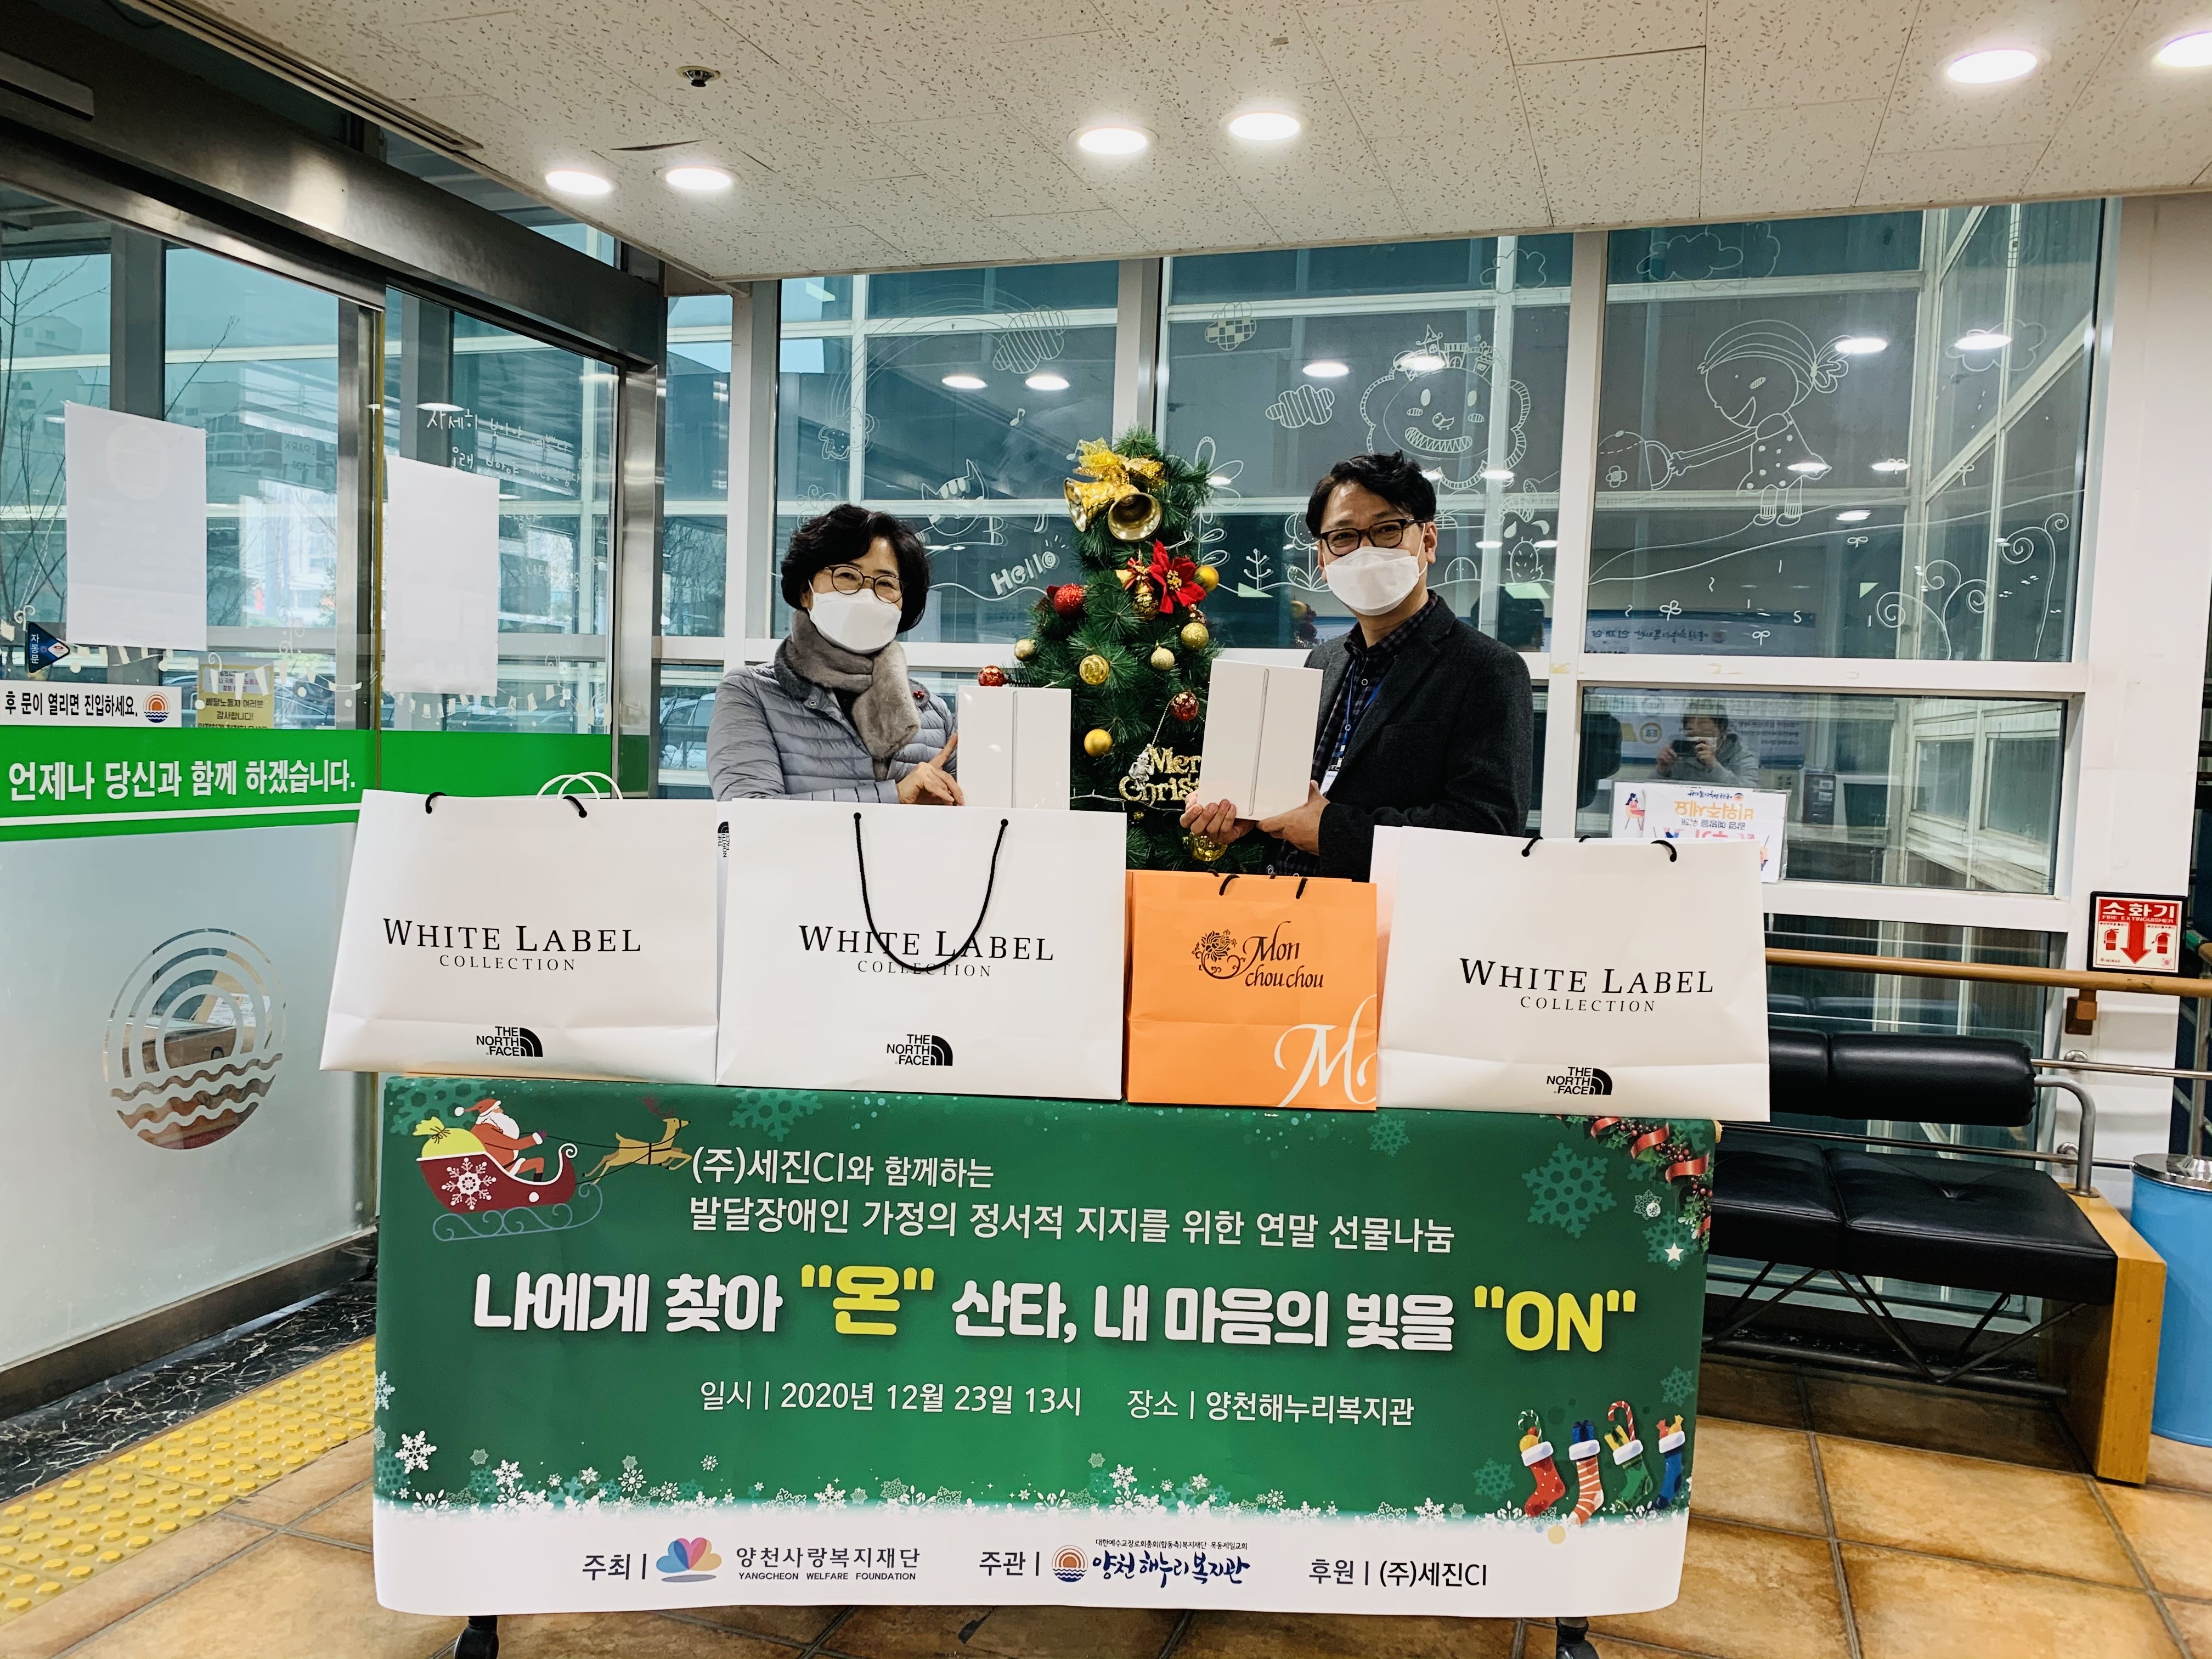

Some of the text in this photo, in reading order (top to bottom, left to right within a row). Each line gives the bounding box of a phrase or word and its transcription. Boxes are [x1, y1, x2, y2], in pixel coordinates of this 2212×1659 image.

[991, 551, 1056, 595] Hello
[5, 691, 138, 716] 후 문이 열리면 진입하세요.
[9, 759, 356, 801] 언제나 당신과 함께 하겠습니다.
[2102, 902, 2175, 918] 소화기
[383, 918, 641, 952] WHITE LABEL
[799, 925, 1054, 961] WHITE LABEL
[1243, 921, 1300, 962] Mon
[439, 955, 575, 971] COLLECTION
[857, 960, 991, 977] COLLECTION
[1459, 958, 1714, 994] WHITE LABEL
[1520, 995, 1656, 1013] COLLECTION
[476, 1035, 519, 1046] NORTH
[494, 1026, 518, 1037] THE
[906, 1034, 930, 1045] THE
[489, 1046, 520, 1057] FACE
[887, 1043, 930, 1055] NORTH
[899, 1054, 929, 1065] FACE
[1546, 1075, 1590, 1086] NORTH
[1567, 1066, 1592, 1076] THE
[1557, 1085, 1589, 1095] FACE
[691, 1147, 994, 1188] (주)세진CI와 함께하는
[690, 1196, 1455, 1254] 발달장애인 가정의 정서적 지지를 위한 연말 선물나눔
[474, 1272, 650, 1332] 나에게
[665, 1273, 783, 1333] 찾아
[951, 1280, 1077, 1343] 산타,
[1094, 1284, 1149, 1341] 내
[1164, 1285, 1329, 1347] 마음의
[1346, 1293, 1455, 1351] 빛을
[700, 1381, 1415, 1426] 일시 2020년 12월 23일 13시 장소 양천해누리복지관
[582, 1547, 921, 1581] 주최 양천사랑복지재단
[979, 1551, 1025, 1576] 주관
[1309, 1559, 1487, 1587] 후원 (주)세진CI
[738, 1572, 916, 1581] YANGCHEON WELFARE FOUNDATION
